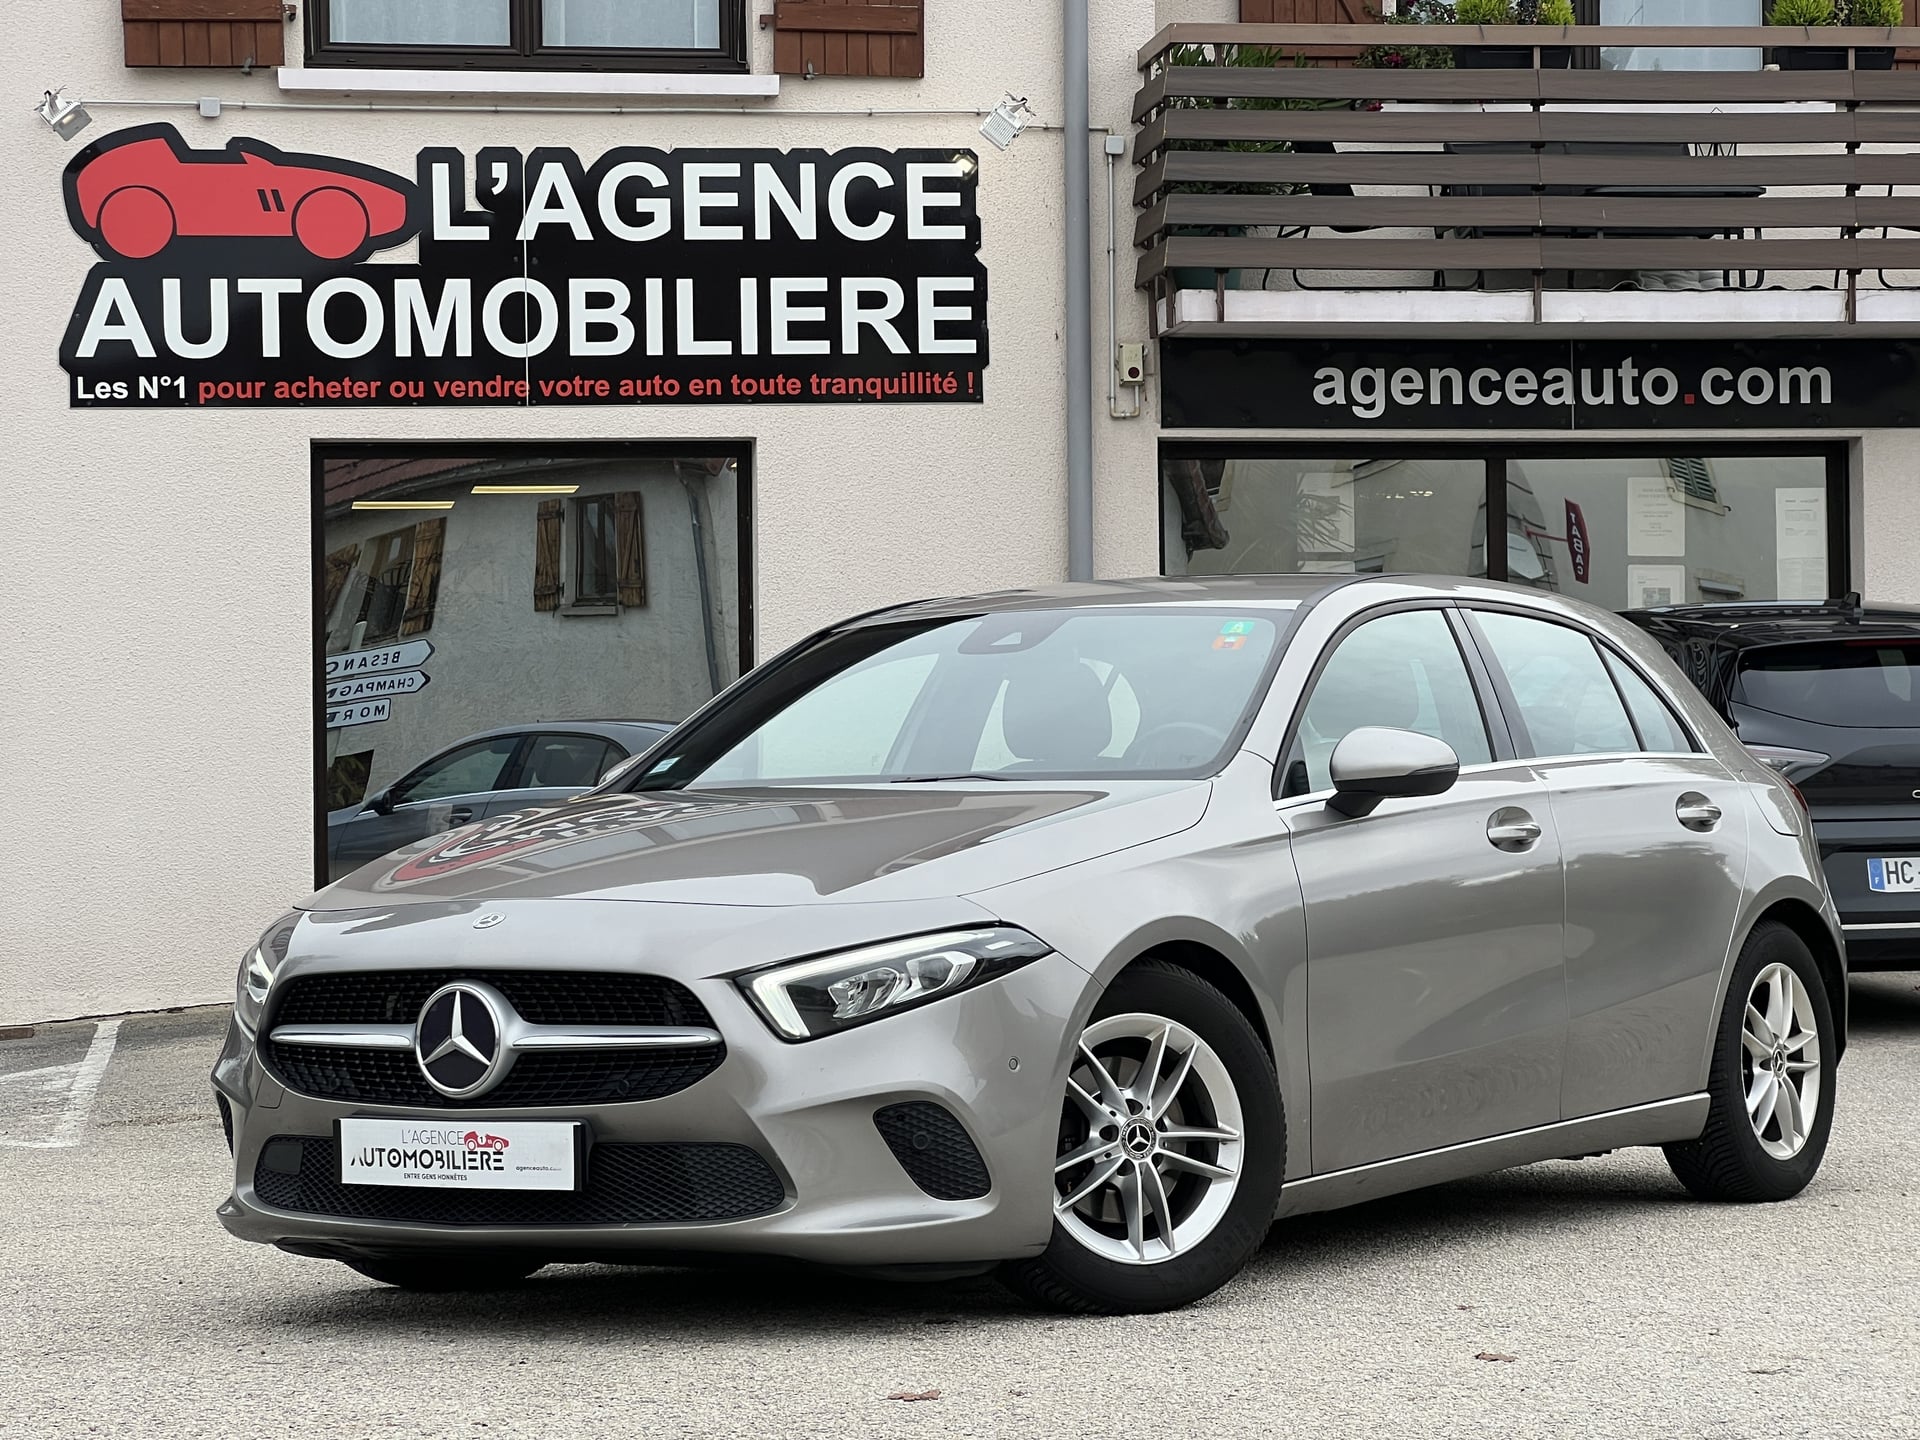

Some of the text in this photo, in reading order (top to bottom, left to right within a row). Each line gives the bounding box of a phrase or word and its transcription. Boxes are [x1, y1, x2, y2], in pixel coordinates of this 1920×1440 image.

[431, 161, 967, 242] L'AGENCE
[75, 276, 978, 360] AUTOMOBILIERE
[76, 371, 976, 404] Les N°1 pour acheter ou vendre votre auto en toute tranquillité !
[1312, 356, 1832, 419] agenceauto.com
[401, 1129, 464, 1146] L'AGENCE
